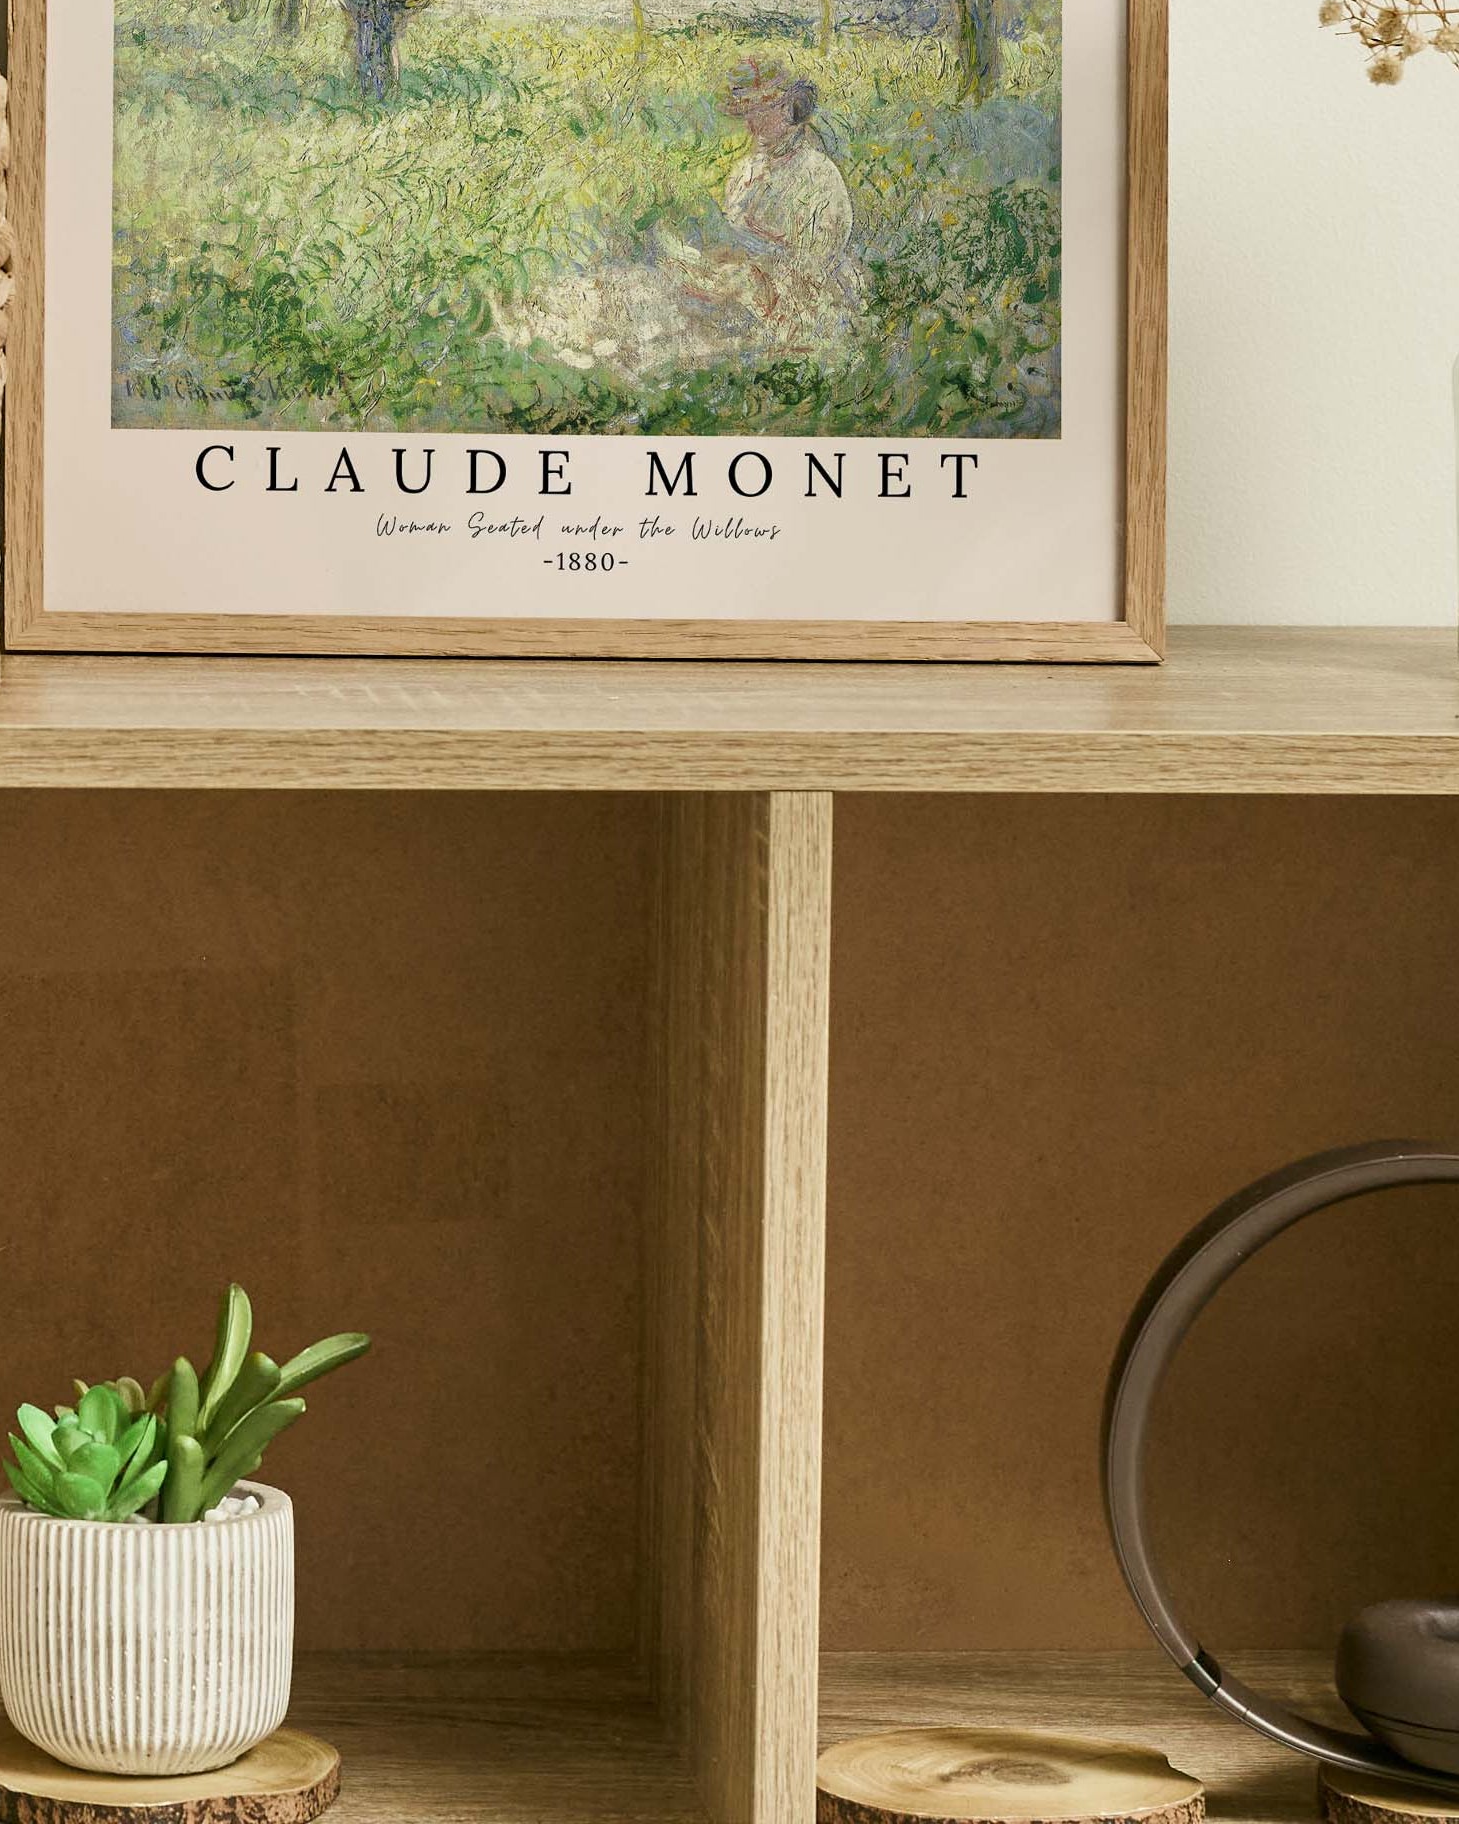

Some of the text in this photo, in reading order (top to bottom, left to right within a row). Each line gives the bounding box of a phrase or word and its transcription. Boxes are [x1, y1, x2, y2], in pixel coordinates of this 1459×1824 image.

[195, 444, 979, 499] CLAUDE MONET
[376, 511, 781, 541] Woman Seated under the Willows
[543, 552, 629, 572] -1880-
